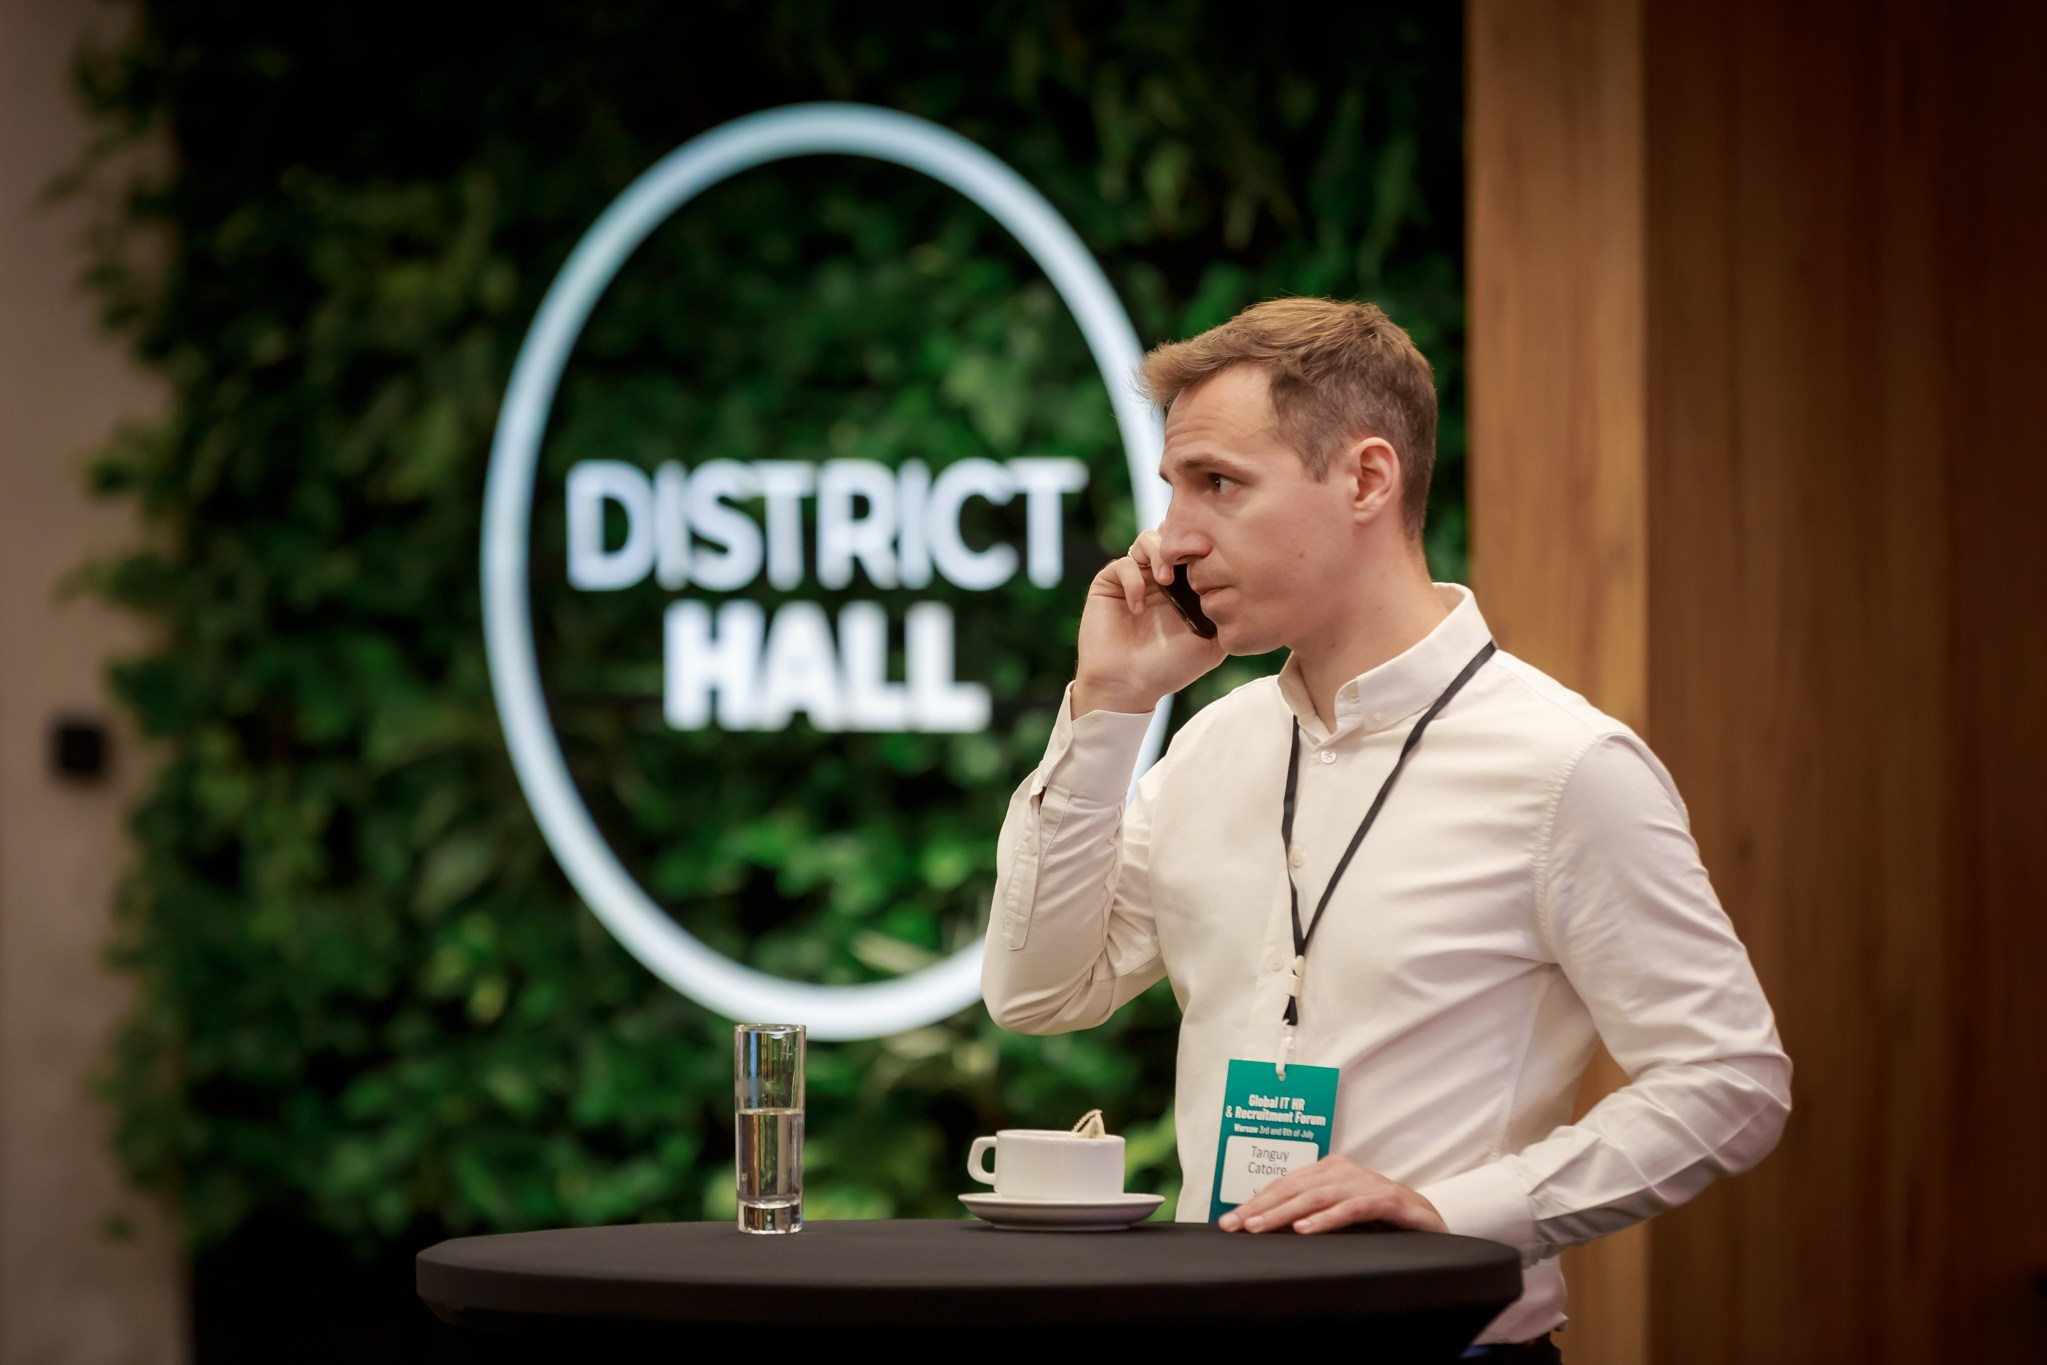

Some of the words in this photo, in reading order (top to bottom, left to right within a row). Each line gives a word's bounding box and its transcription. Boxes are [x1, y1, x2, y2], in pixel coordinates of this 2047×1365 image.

[565, 458, 1089, 591] DISTRICT
[663, 601, 992, 733] HALL
[1248, 1093, 1279, 1109] Global
[1279, 1096, 1290, 1109] IT
[1291, 1098, 1305, 1111] HR
[1225, 1105, 1233, 1118] &
[1235, 1106, 1294, 1123] Recruitment
[1295, 1111, 1326, 1126] Forum
[1234, 1123, 1258, 1133] Warsaw
[1270, 1127, 1282, 1136] and
[1293, 1129, 1300, 1138] of
[1301, 1129, 1314, 1140] July
[1251, 1145, 1290, 1163] Tanguy
[1248, 1161, 1287, 1176] Catoire
